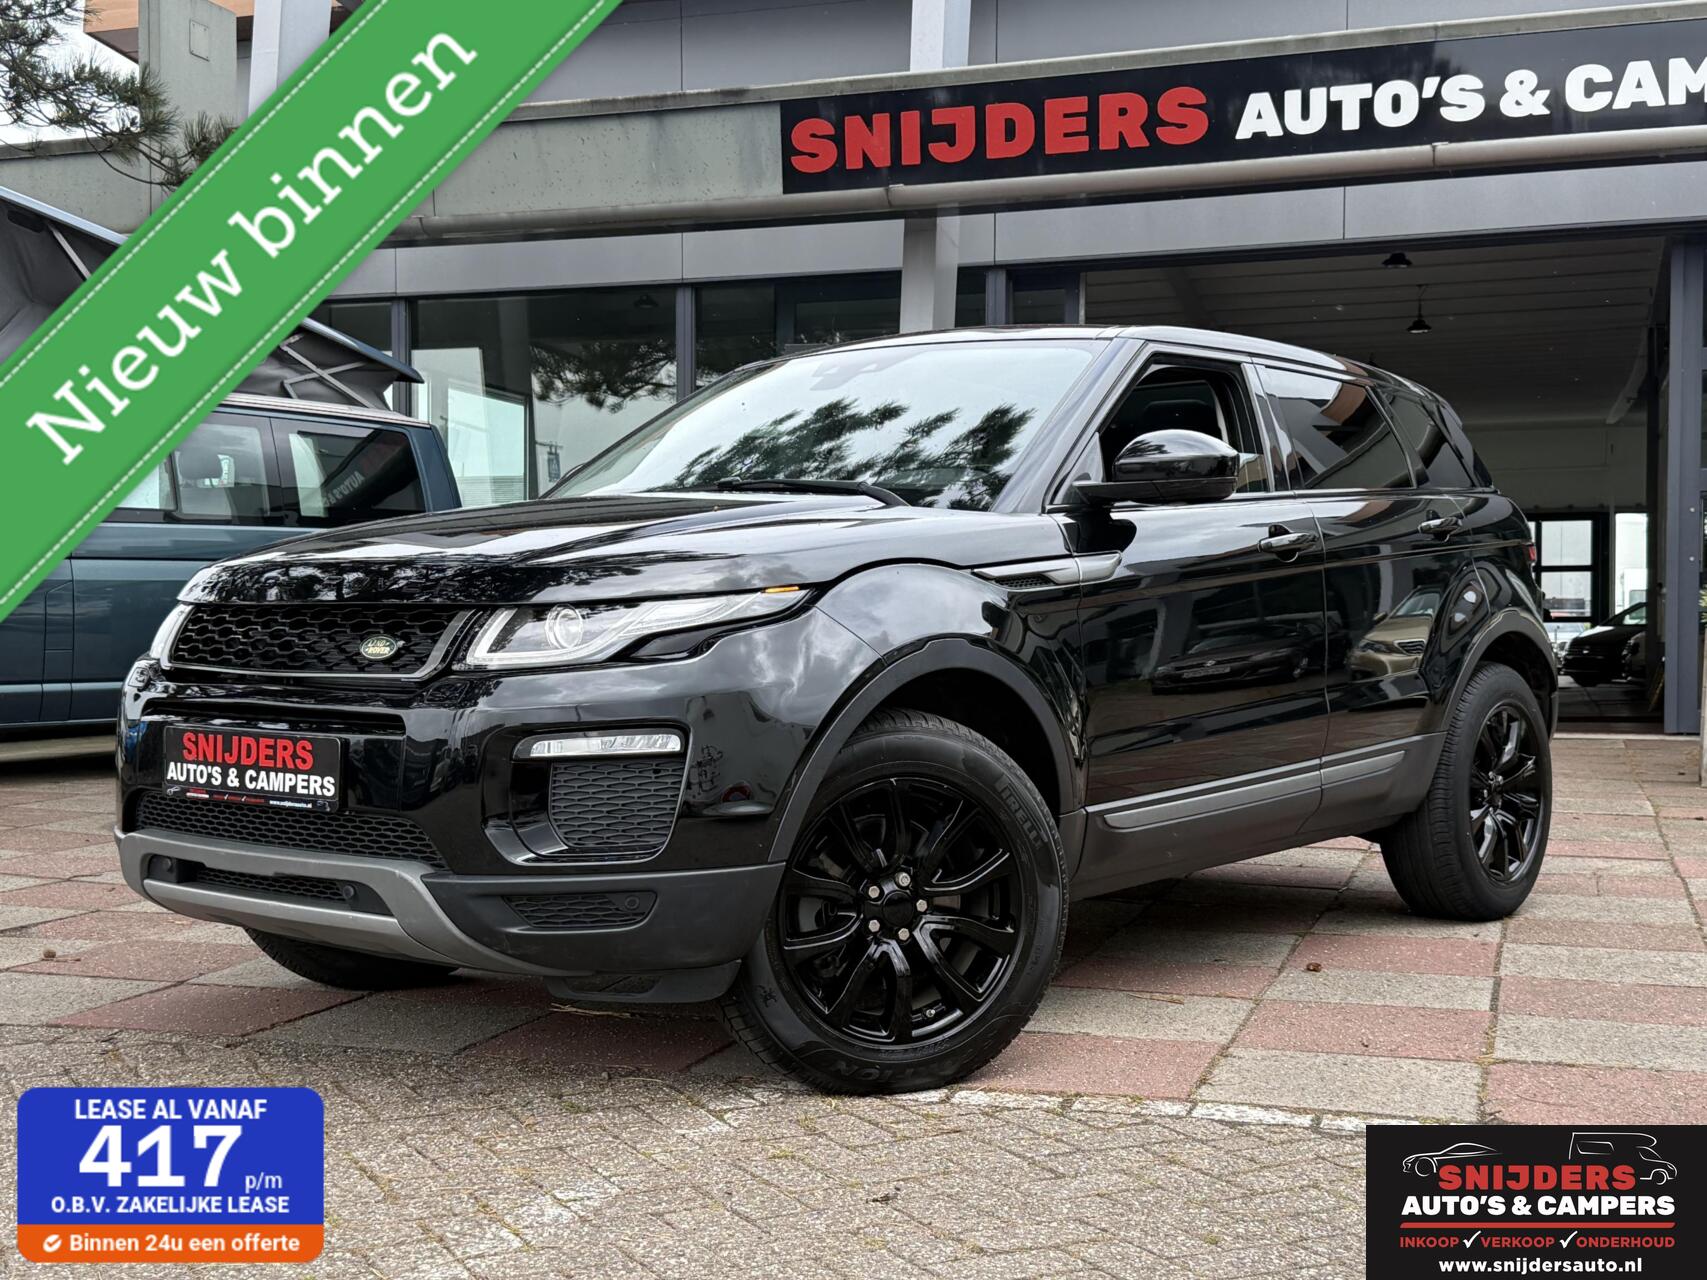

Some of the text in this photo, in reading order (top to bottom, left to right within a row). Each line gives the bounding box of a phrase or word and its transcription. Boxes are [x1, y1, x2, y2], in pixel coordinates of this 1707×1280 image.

[790, 86, 1210, 174] SNIJDERS
[1234, 74, 1486, 141] AUTO'S
[1498, 68, 1551, 119] &
[182, 731, 314, 771] SNIJDERS
[166, 761, 336, 797] AUTO'S & CAMPERS
